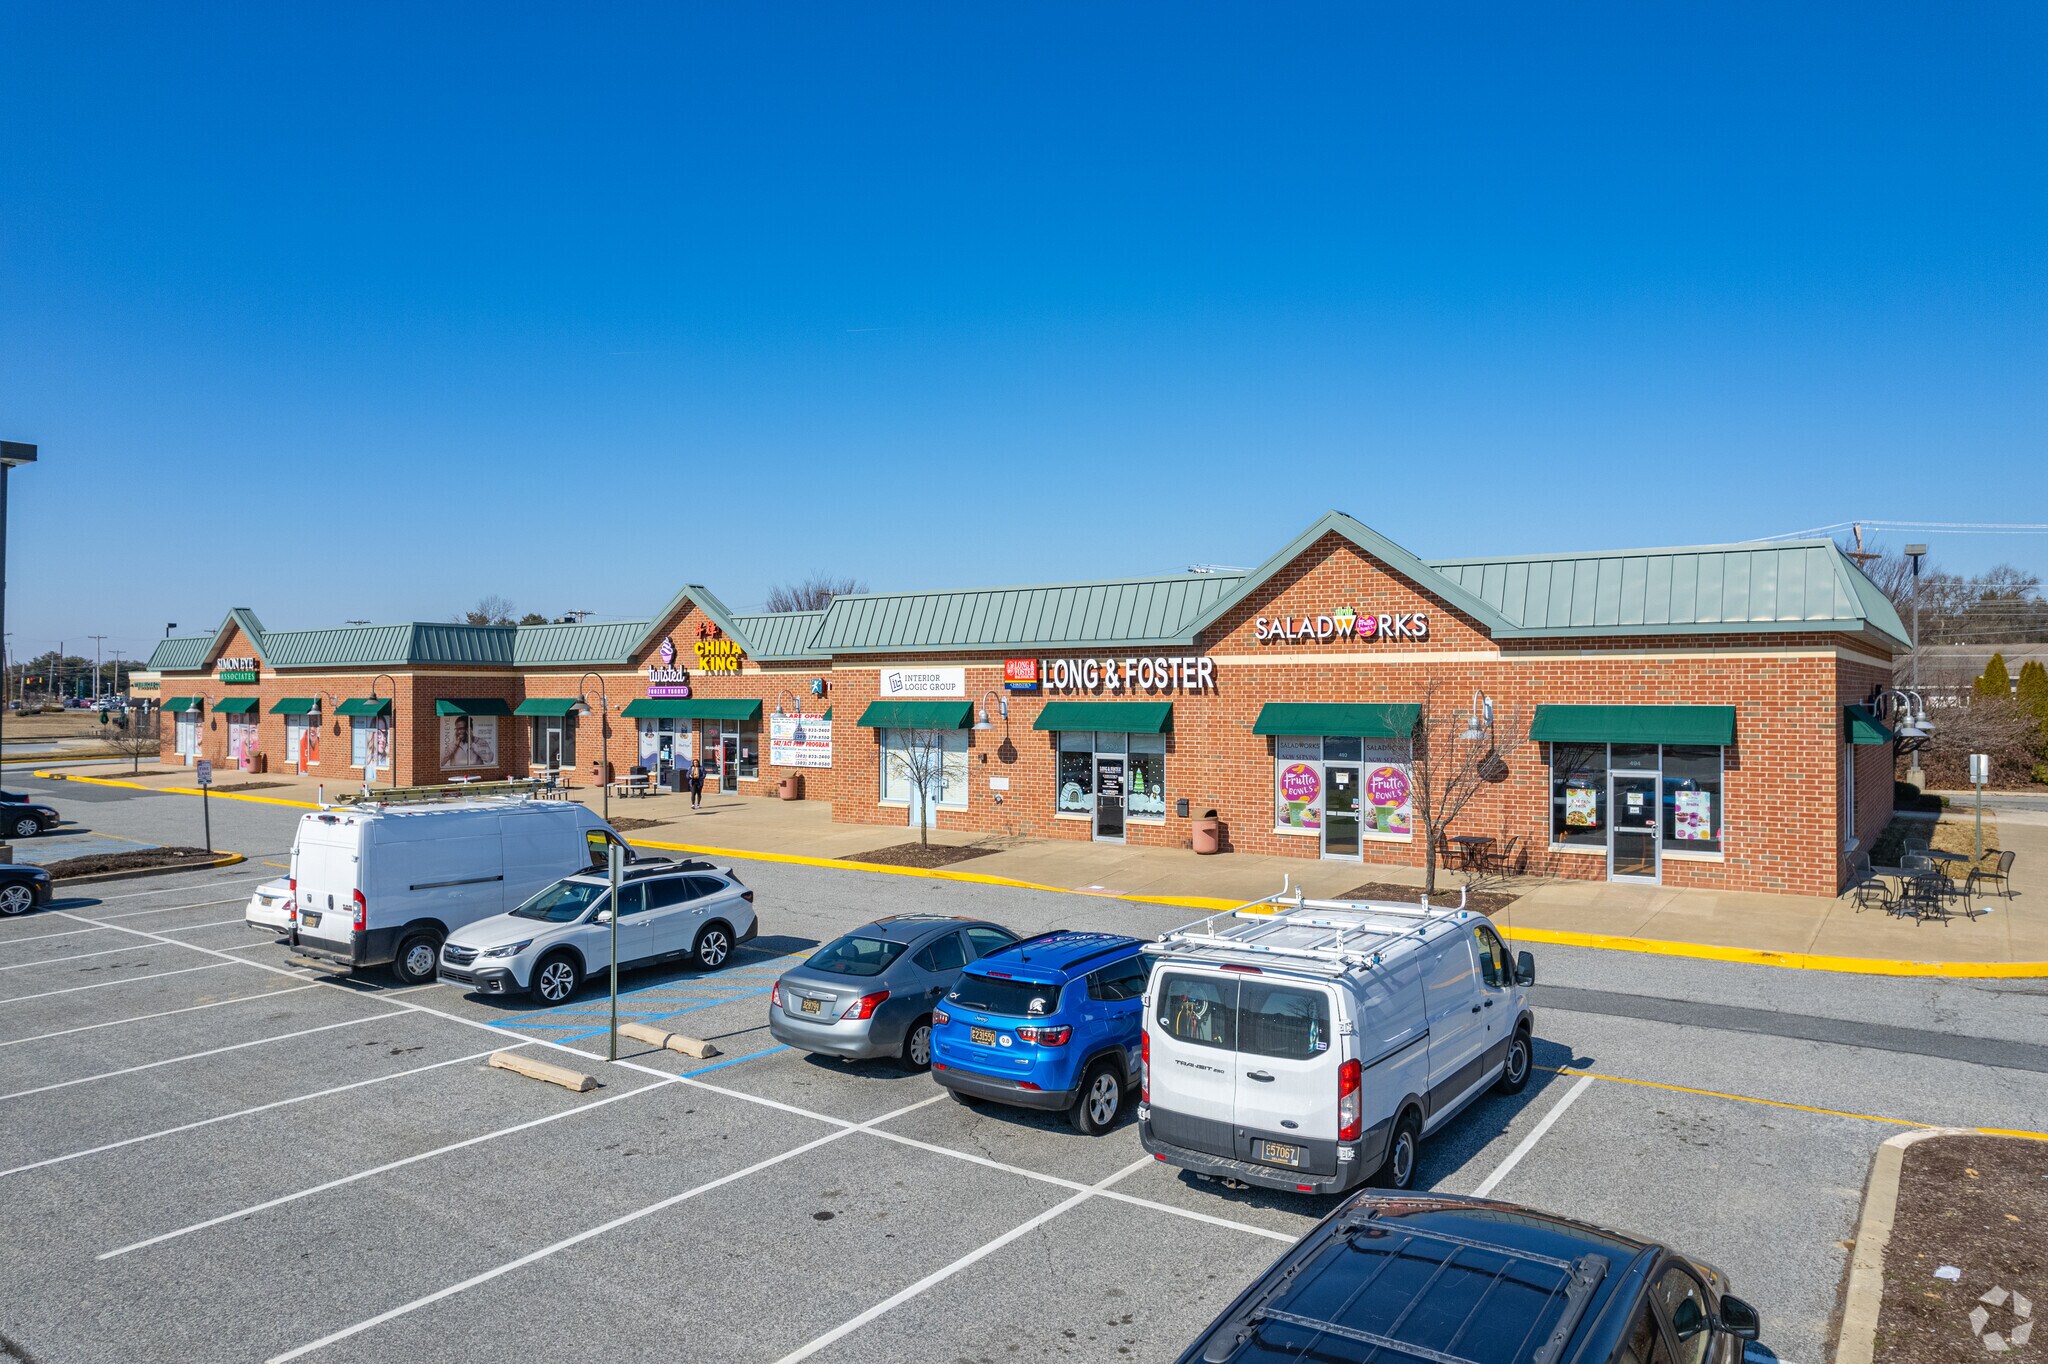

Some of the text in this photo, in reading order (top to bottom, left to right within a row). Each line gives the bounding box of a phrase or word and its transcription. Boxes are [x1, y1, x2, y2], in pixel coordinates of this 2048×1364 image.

[1255, 613, 1427, 639] SALADWORKS
[694, 641, 742, 655] CHINA
[217, 658, 254, 669] SIMON EYE
[699, 656, 738, 670] KING
[221, 673, 255, 681] ASSOCIATES
[648, 664, 685, 682] twisted
[1043, 657, 1214, 688] LONG & FOSTER
[905, 683, 956, 691] LOGIC GROUP
[1284, 772, 1316, 789] Frutta
[1370, 775, 1404, 793] Frutta
[1288, 785, 1313, 796] BOWLS
[1375, 789, 1402, 799] BOWLS
[1175, 1060, 1213, 1071] TRANSIT
